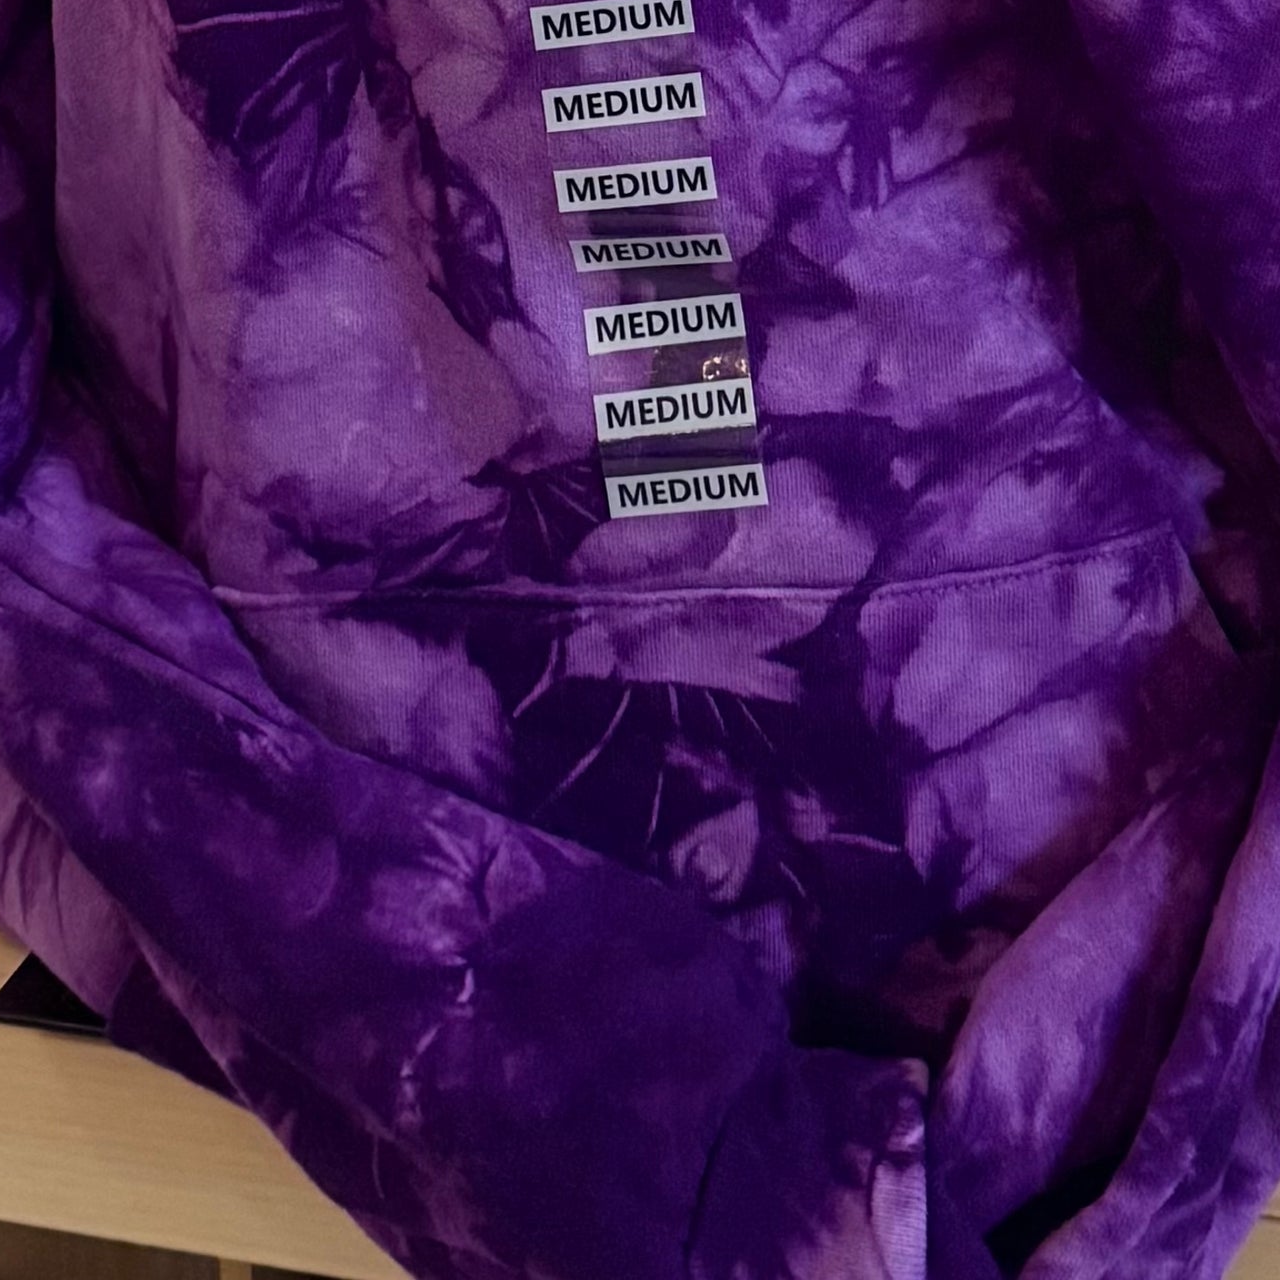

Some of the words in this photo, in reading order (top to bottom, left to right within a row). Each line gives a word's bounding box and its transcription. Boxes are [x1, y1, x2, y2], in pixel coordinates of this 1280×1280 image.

[541, 0, 686, 40] MEDIUM
[553, 81, 697, 123] MEDIUM
[565, 165, 709, 204] MEDIUM
[581, 237, 724, 264] MEDIUM
[595, 301, 738, 343] MEDIUM
[605, 386, 749, 429] MEDIUM
[617, 471, 760, 508] MEDIUM
